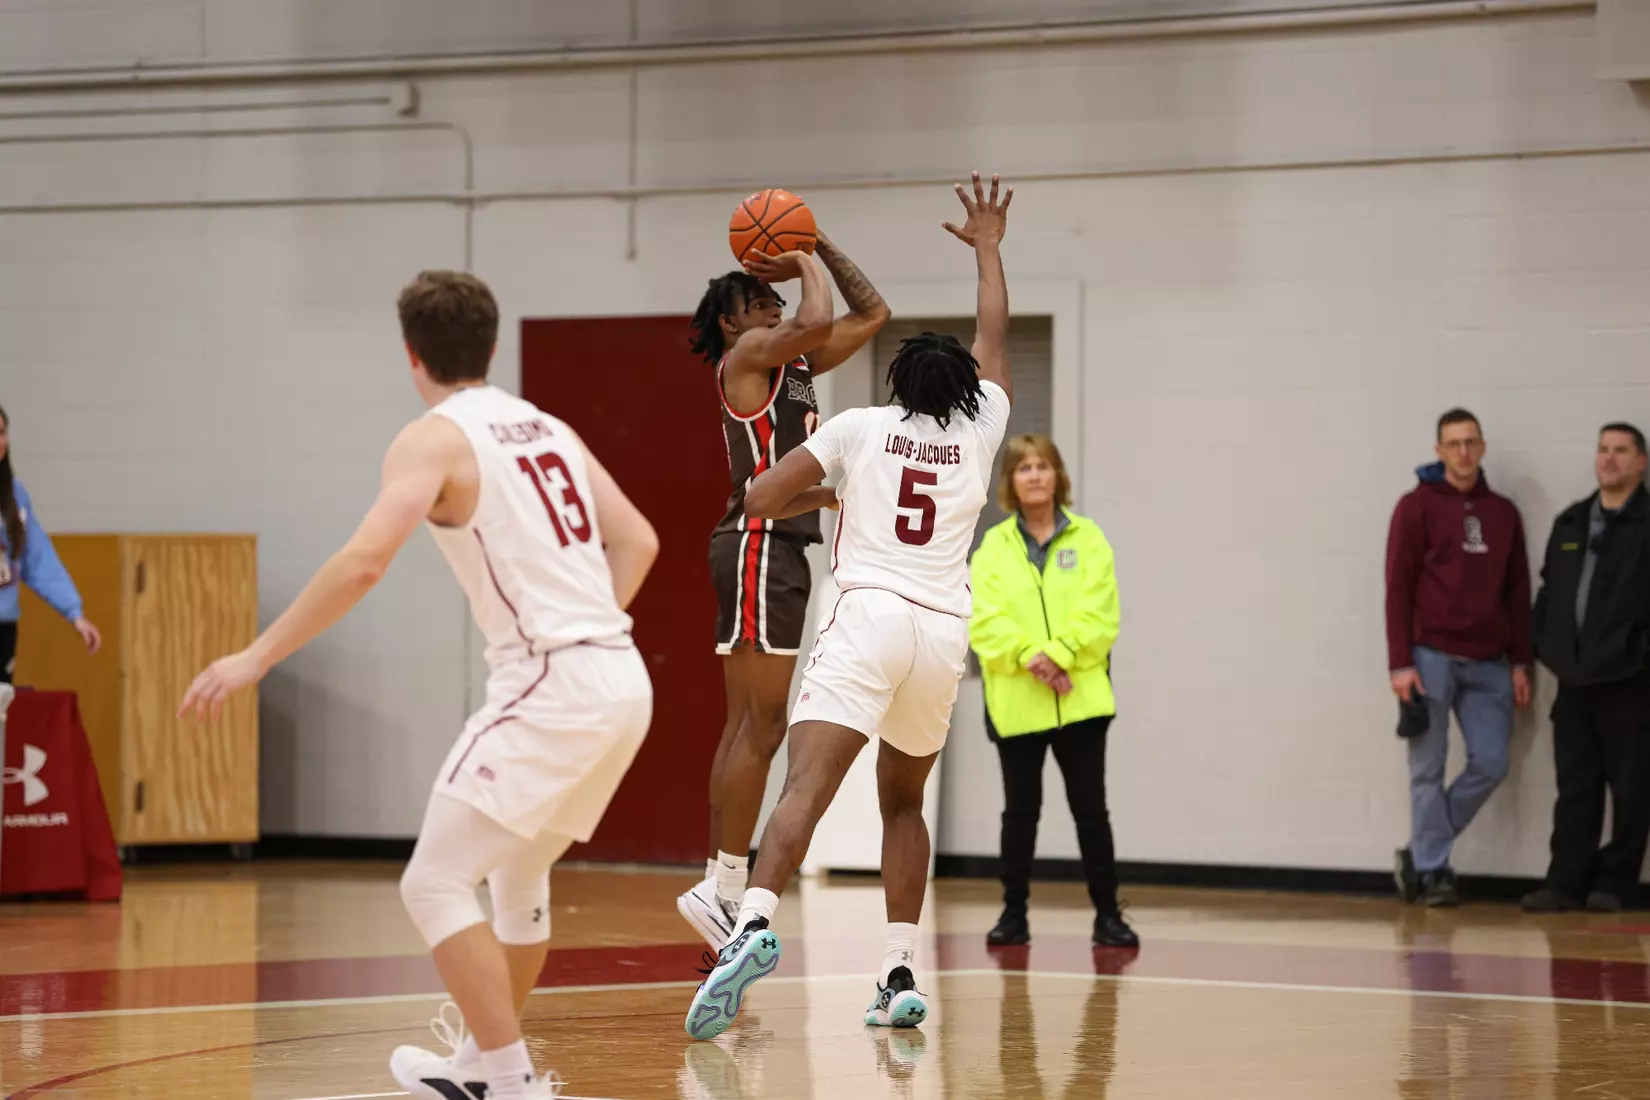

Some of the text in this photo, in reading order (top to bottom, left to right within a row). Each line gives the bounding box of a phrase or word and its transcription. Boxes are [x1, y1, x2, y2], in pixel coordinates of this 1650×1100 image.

[884, 433, 960, 465] LOUIS-JACQUES
[515, 451, 592, 548] 13
[895, 465, 938, 546] 5
